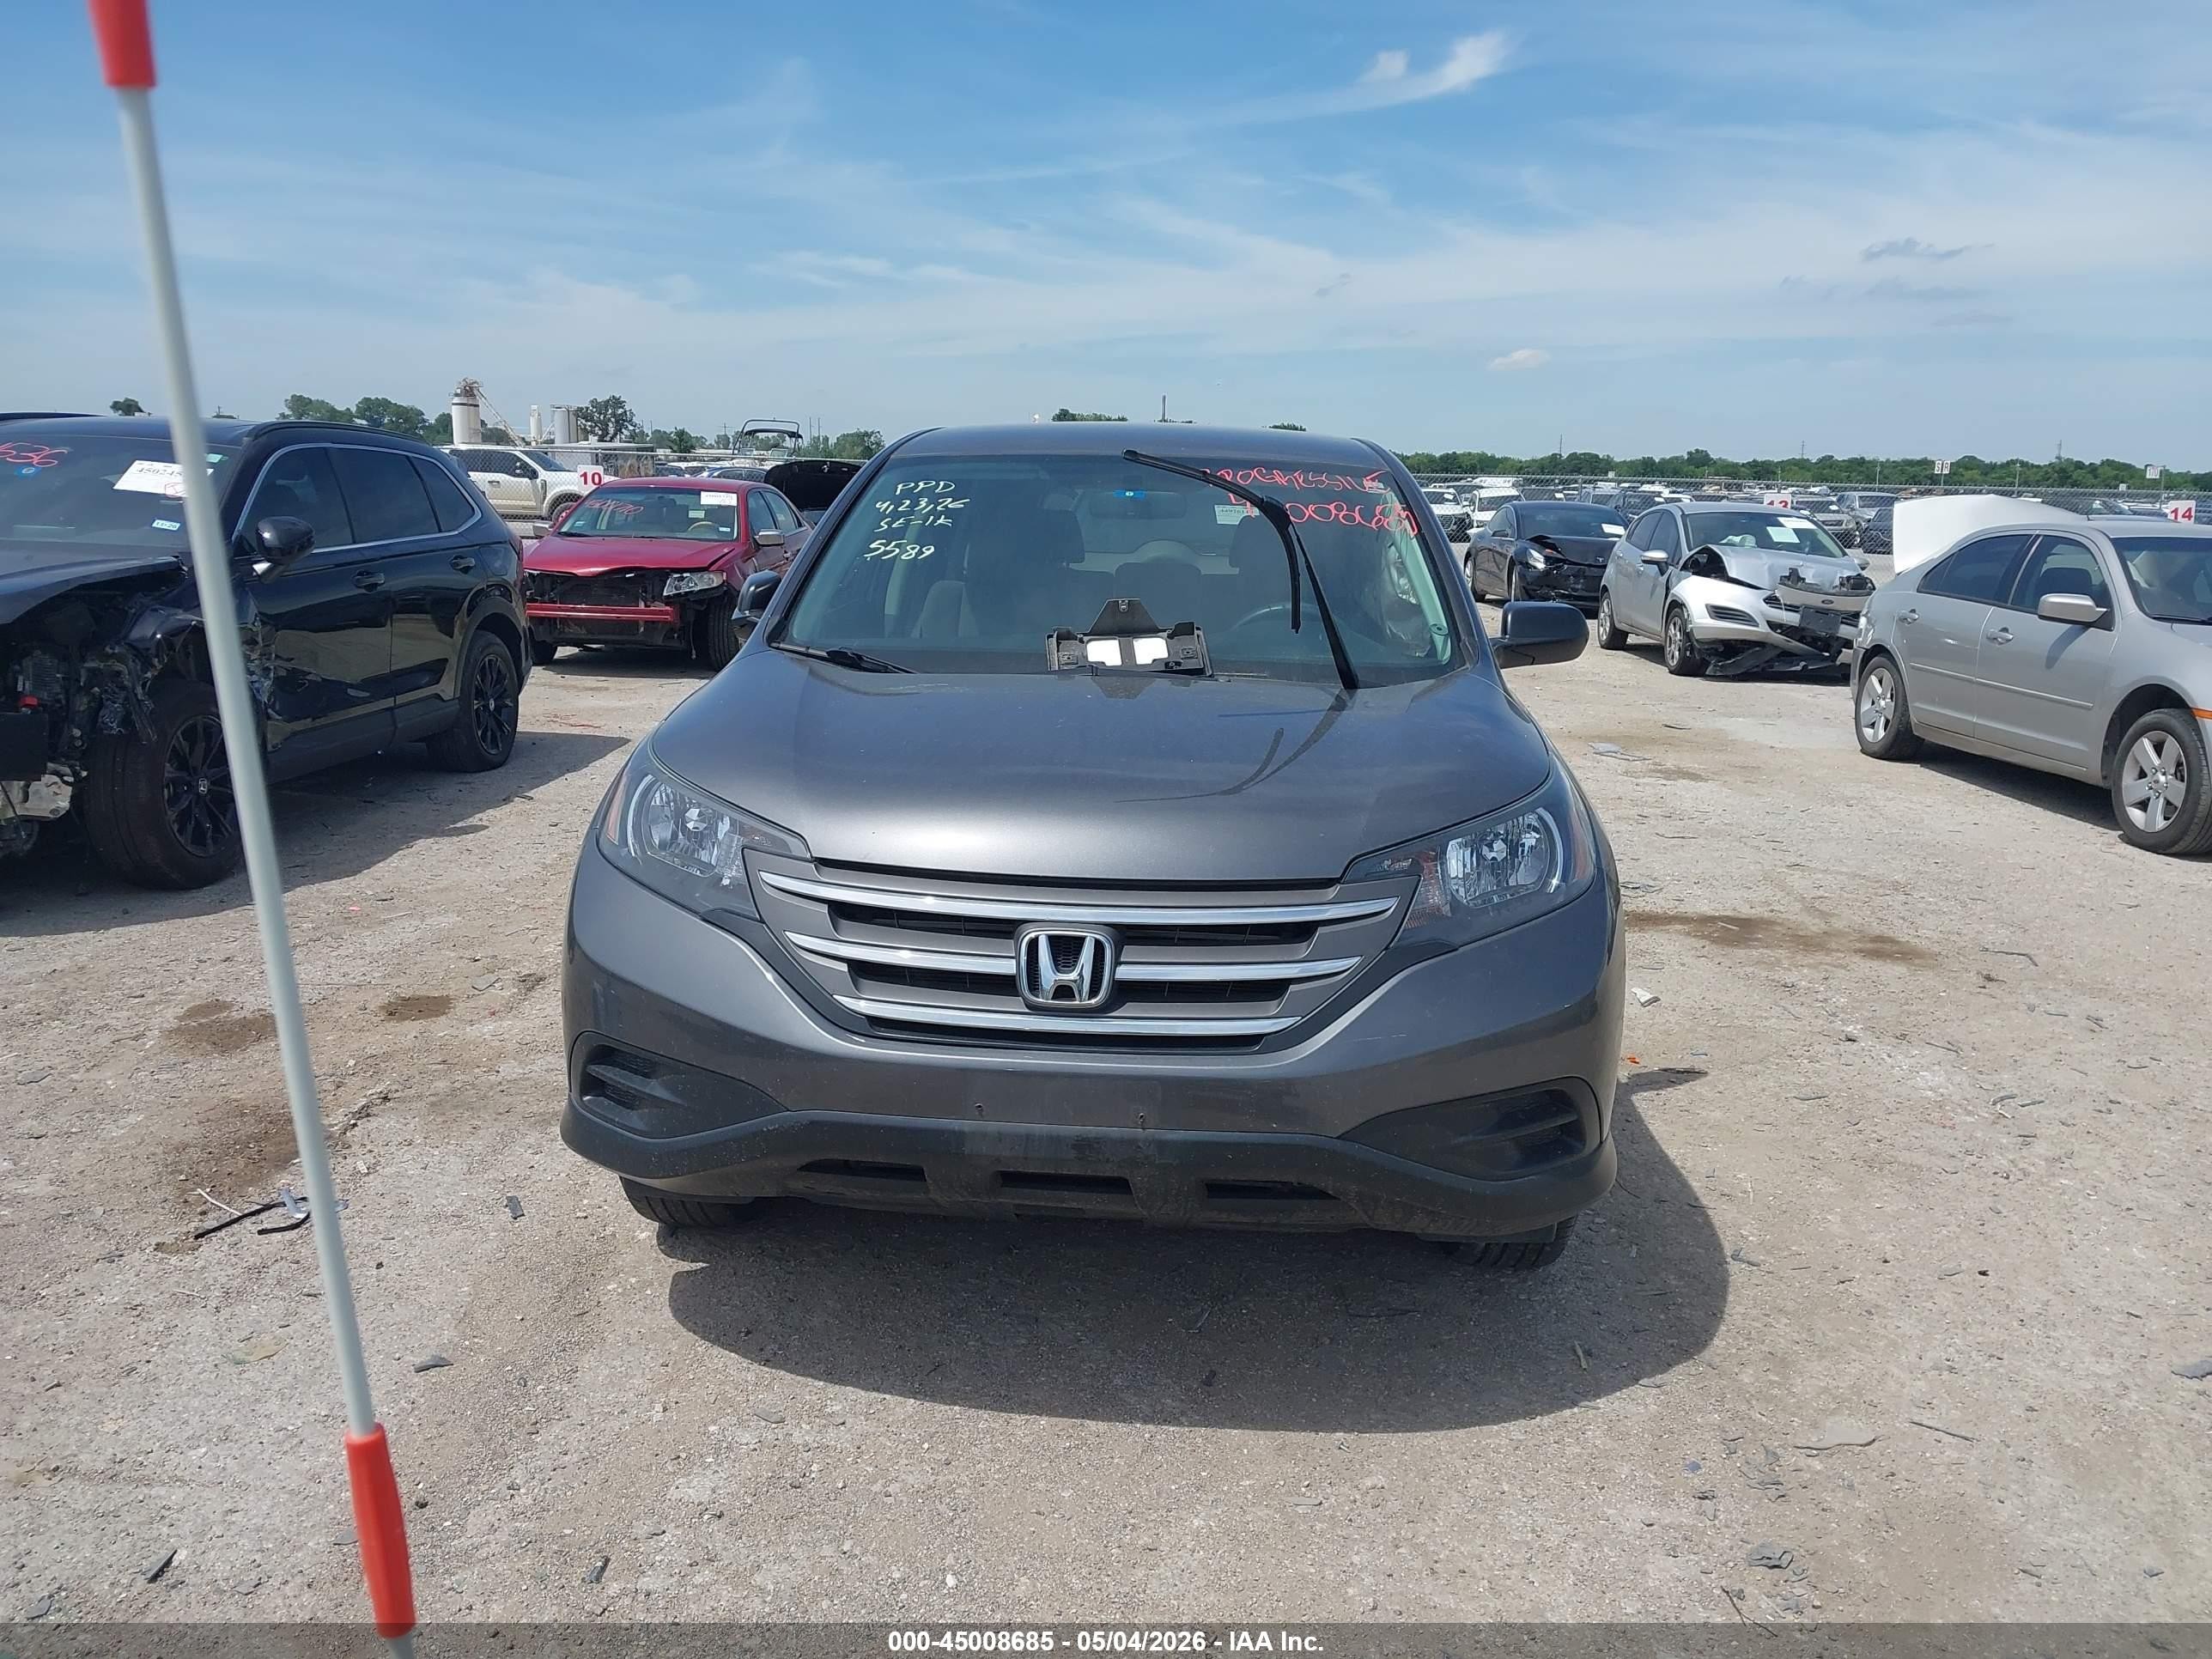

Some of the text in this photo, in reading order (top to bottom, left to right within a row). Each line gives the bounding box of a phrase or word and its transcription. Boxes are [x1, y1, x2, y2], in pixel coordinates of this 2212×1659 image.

[580, 471, 602, 486] 10
[896, 481, 956, 495] PPD
[2170, 507, 2193, 521] 14
[864, 539, 935, 561] 5589
